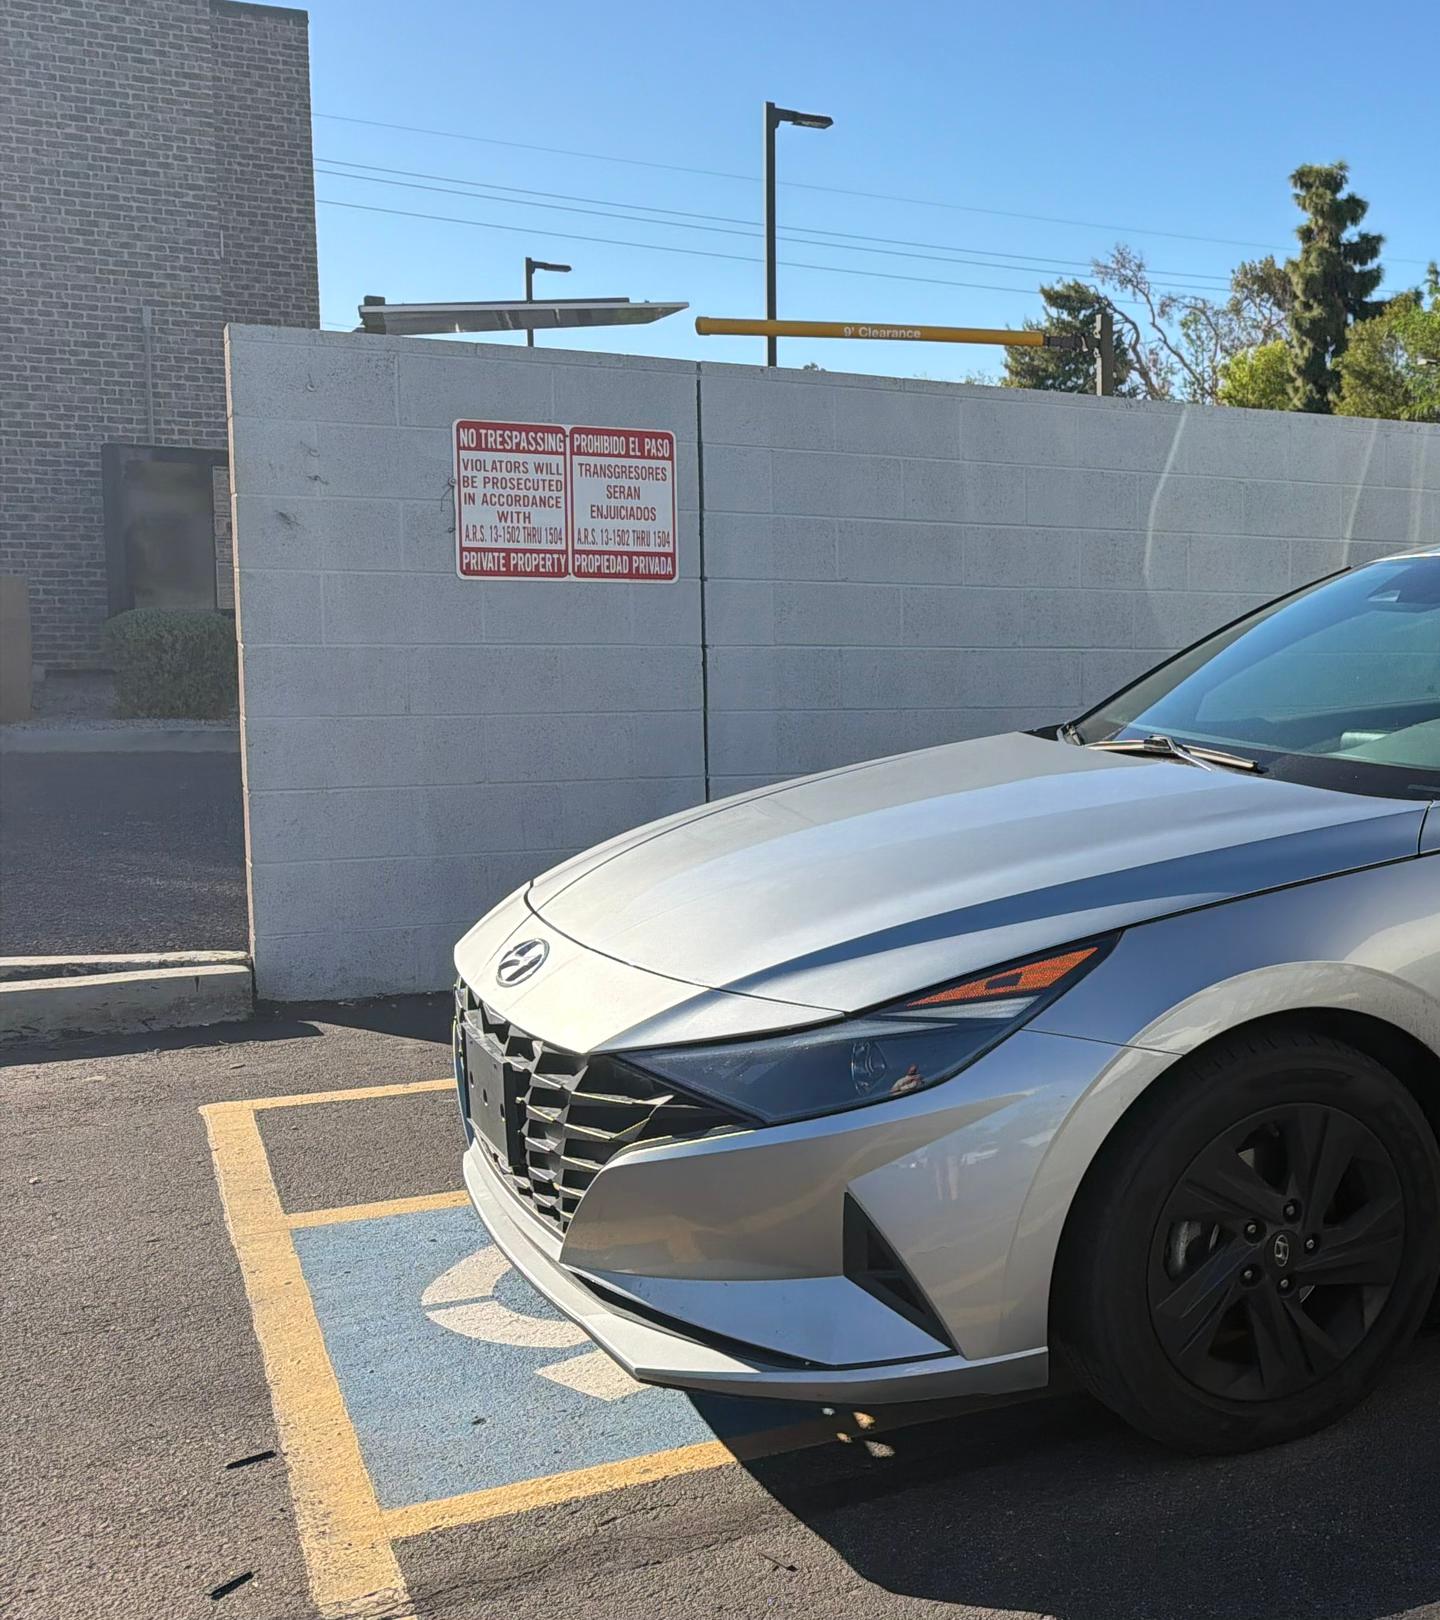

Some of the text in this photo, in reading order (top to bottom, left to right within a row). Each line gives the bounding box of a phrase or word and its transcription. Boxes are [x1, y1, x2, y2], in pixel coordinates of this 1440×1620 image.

[859, 326, 921, 338] Clearance
[460, 428, 564, 452] NO TRESPASSING
[574, 433, 670, 458] PROHIBIDO EL PASO
[462, 458, 563, 476] VIOLATORS WILL
[578, 463, 667, 482] TRANSGRESORES
[462, 476, 563, 492] BE PROSECUTED
[606, 484, 641, 501] SERAN
[464, 493, 562, 509] IN ACCORDANCE
[497, 511, 531, 524] WITH
[590, 504, 657, 522] ENJUICIADOS
[465, 524, 563, 545] A.R.S. 13-1502 THRU 1504
[577, 528, 671, 548] A.R.S. 13-1502 THRU 1504
[462, 551, 567, 573] PRIVATE PROPERTY
[574, 554, 673, 575] PROPIEDAD PRIVADA
